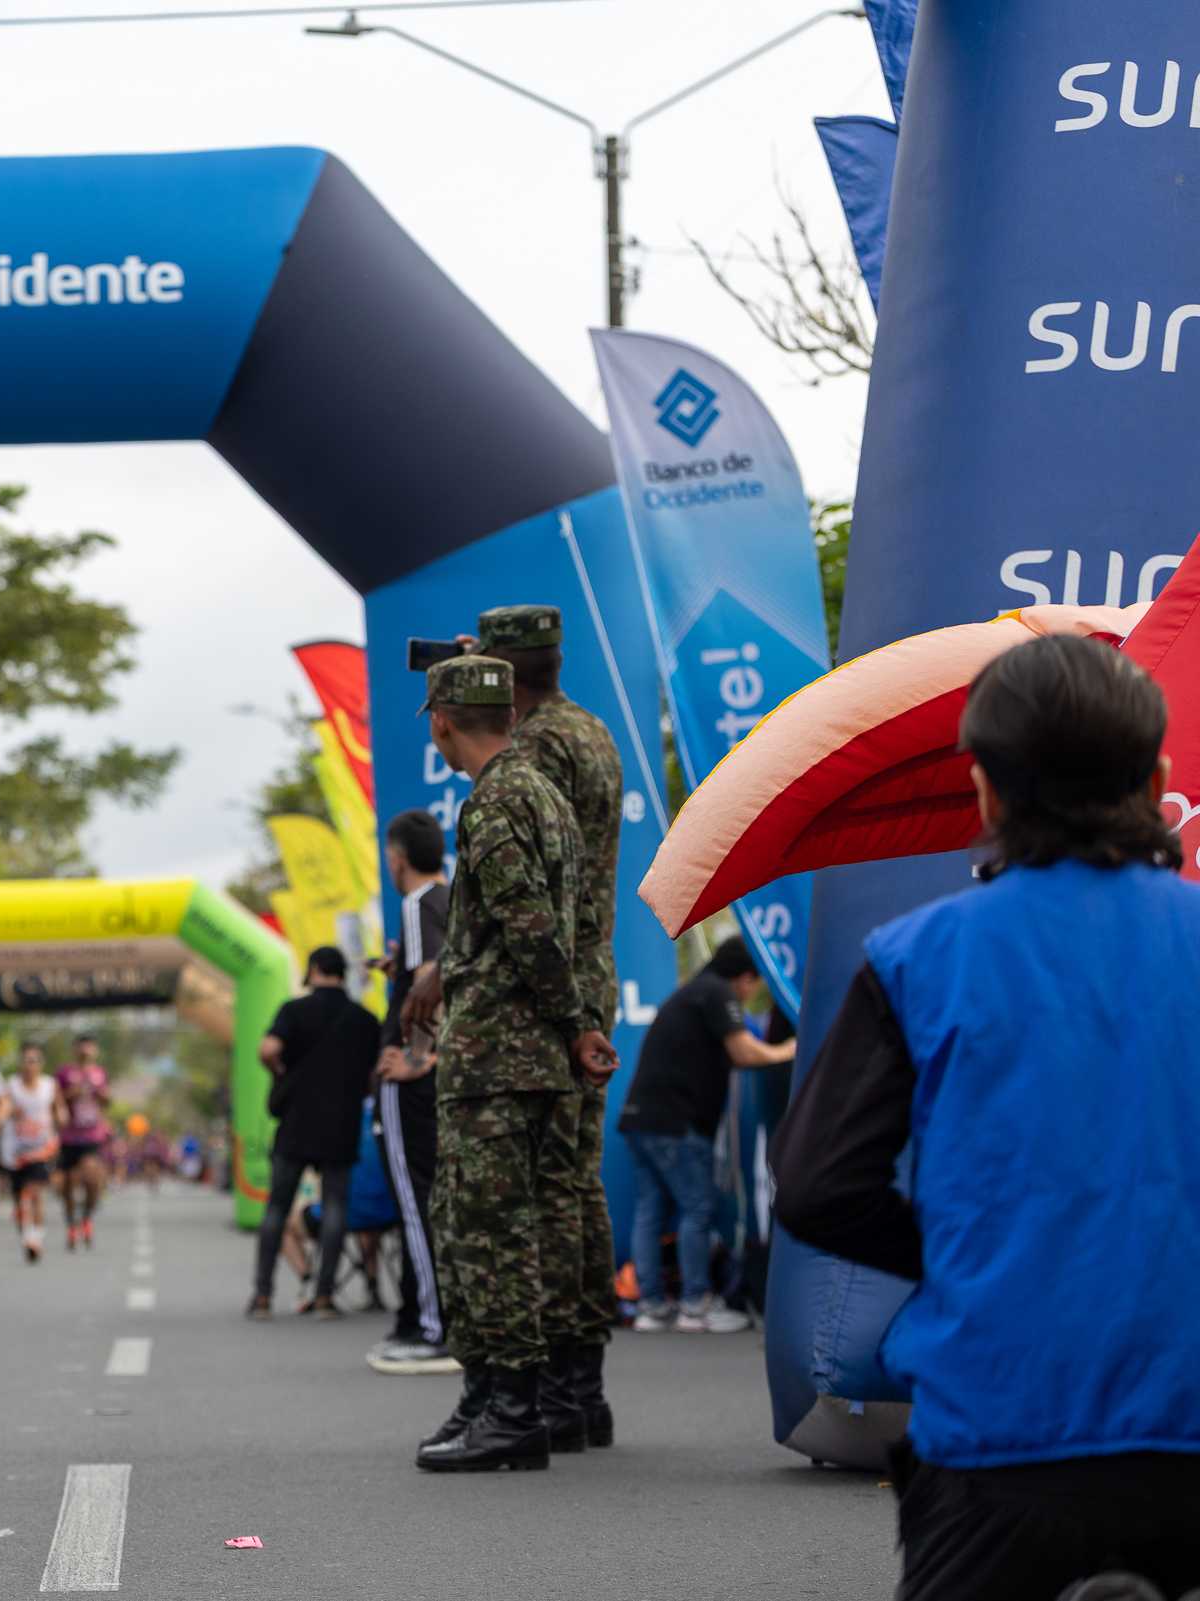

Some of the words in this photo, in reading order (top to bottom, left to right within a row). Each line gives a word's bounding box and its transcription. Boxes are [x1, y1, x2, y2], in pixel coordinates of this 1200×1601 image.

[1055, 60, 1200, 132] su
[644, 459, 718, 483] Banco
[722, 450, 753, 473] de
[643, 478, 765, 510] Occidente
[701, 641, 764, 748] te!
